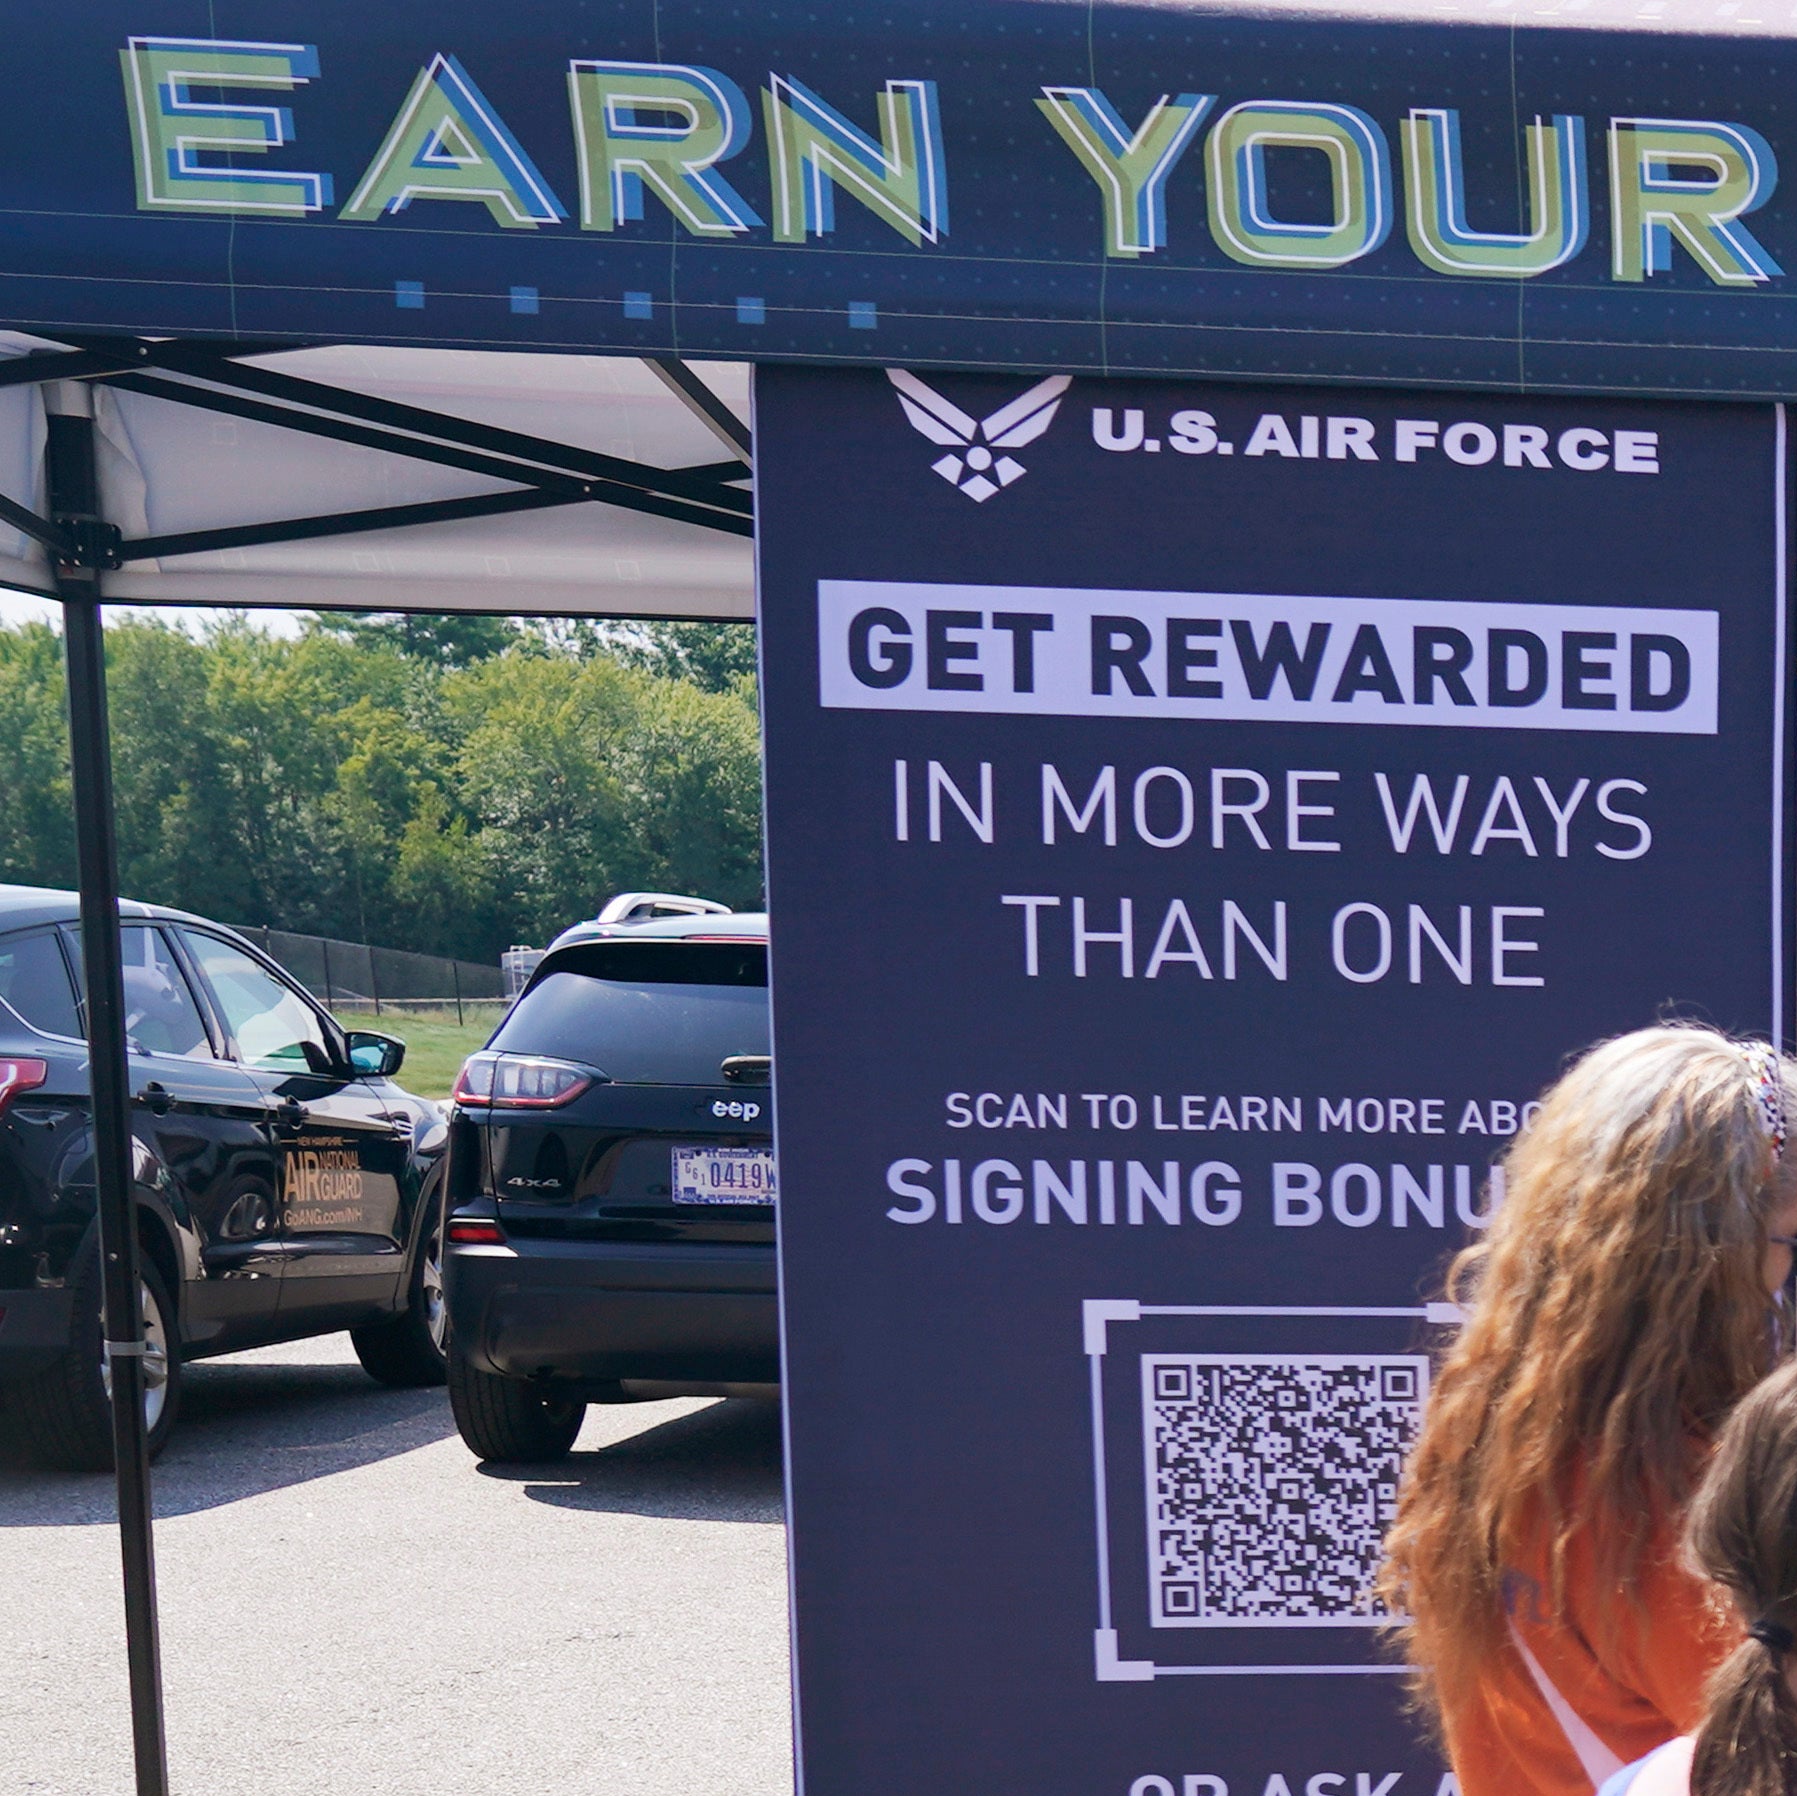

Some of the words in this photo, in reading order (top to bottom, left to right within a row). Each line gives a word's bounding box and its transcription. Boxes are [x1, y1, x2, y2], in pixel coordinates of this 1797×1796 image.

[120, 37, 948, 245] EARN
[1034, 84, 1786, 288] YOUR
[1092, 409, 1233, 455] U.S.
[1244, 415, 1379, 461] AIR
[1396, 420, 1660, 475] FORCE
[846, 606, 1054, 694] GET
[1091, 615, 1692, 713] REWARDED
[893, 759, 993, 845] IN
[1042, 765, 1340, 852] MORE
[1375, 773, 1653, 861] WAYS
[1002, 895, 1287, 981] THAN
[1333, 903, 1545, 986] ONE
[712, 1101, 760, 1121] eep
[946, 1092, 1068, 1132] SCAN
[1082, 1093, 1139, 1132] TO
[1154, 1094, 1303, 1133] LEARN
[1319, 1097, 1445, 1134] MORE
[284, 1151, 320, 1202] AIR
[320, 1173, 362, 1201] GUARD
[886, 1158, 1243, 1227] SIGNING
[1274, 1163, 1502, 1229] BONU
